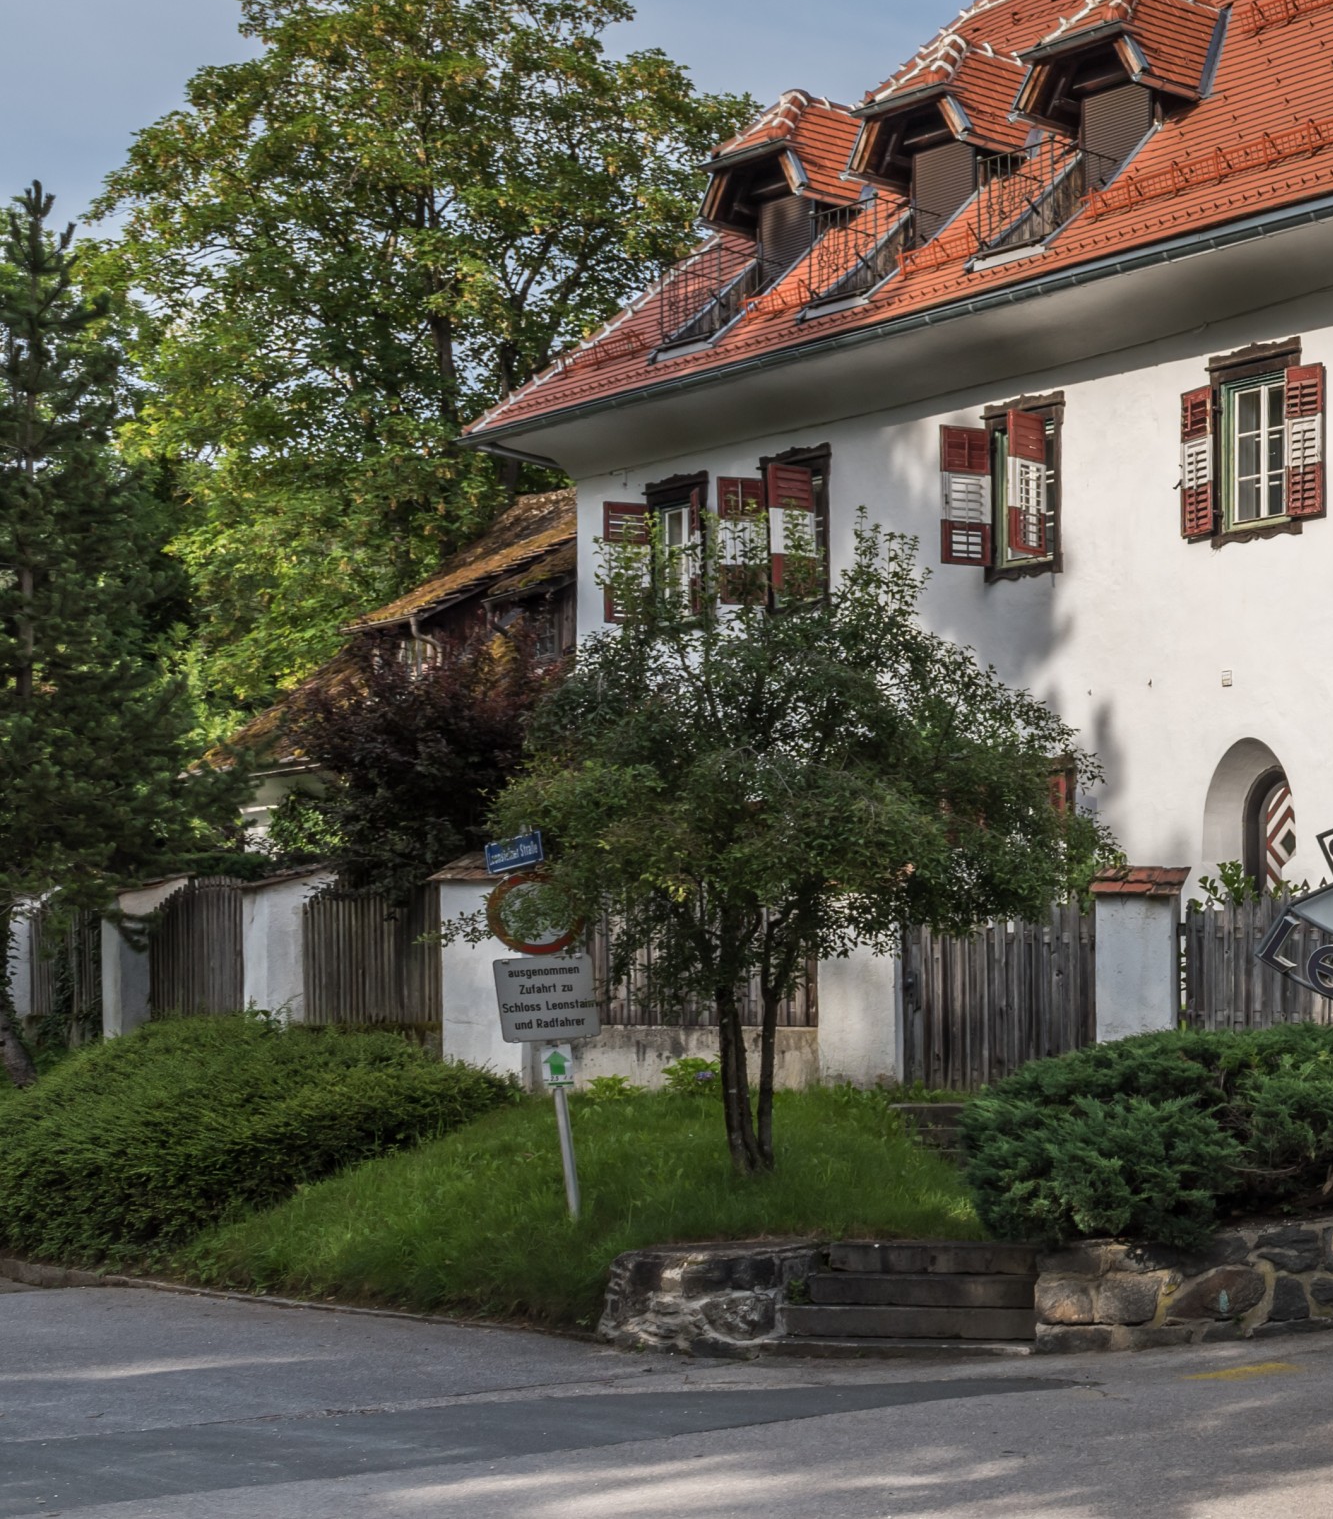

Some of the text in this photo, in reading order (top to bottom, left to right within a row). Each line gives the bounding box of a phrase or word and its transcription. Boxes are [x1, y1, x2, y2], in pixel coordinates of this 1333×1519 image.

[508, 966, 580, 980] ausgenommen
[519, 983, 574, 995] Zufahrt zu
[502, 1002, 542, 1014] Schloss
[514, 1017, 586, 1030] und Radfahrer
